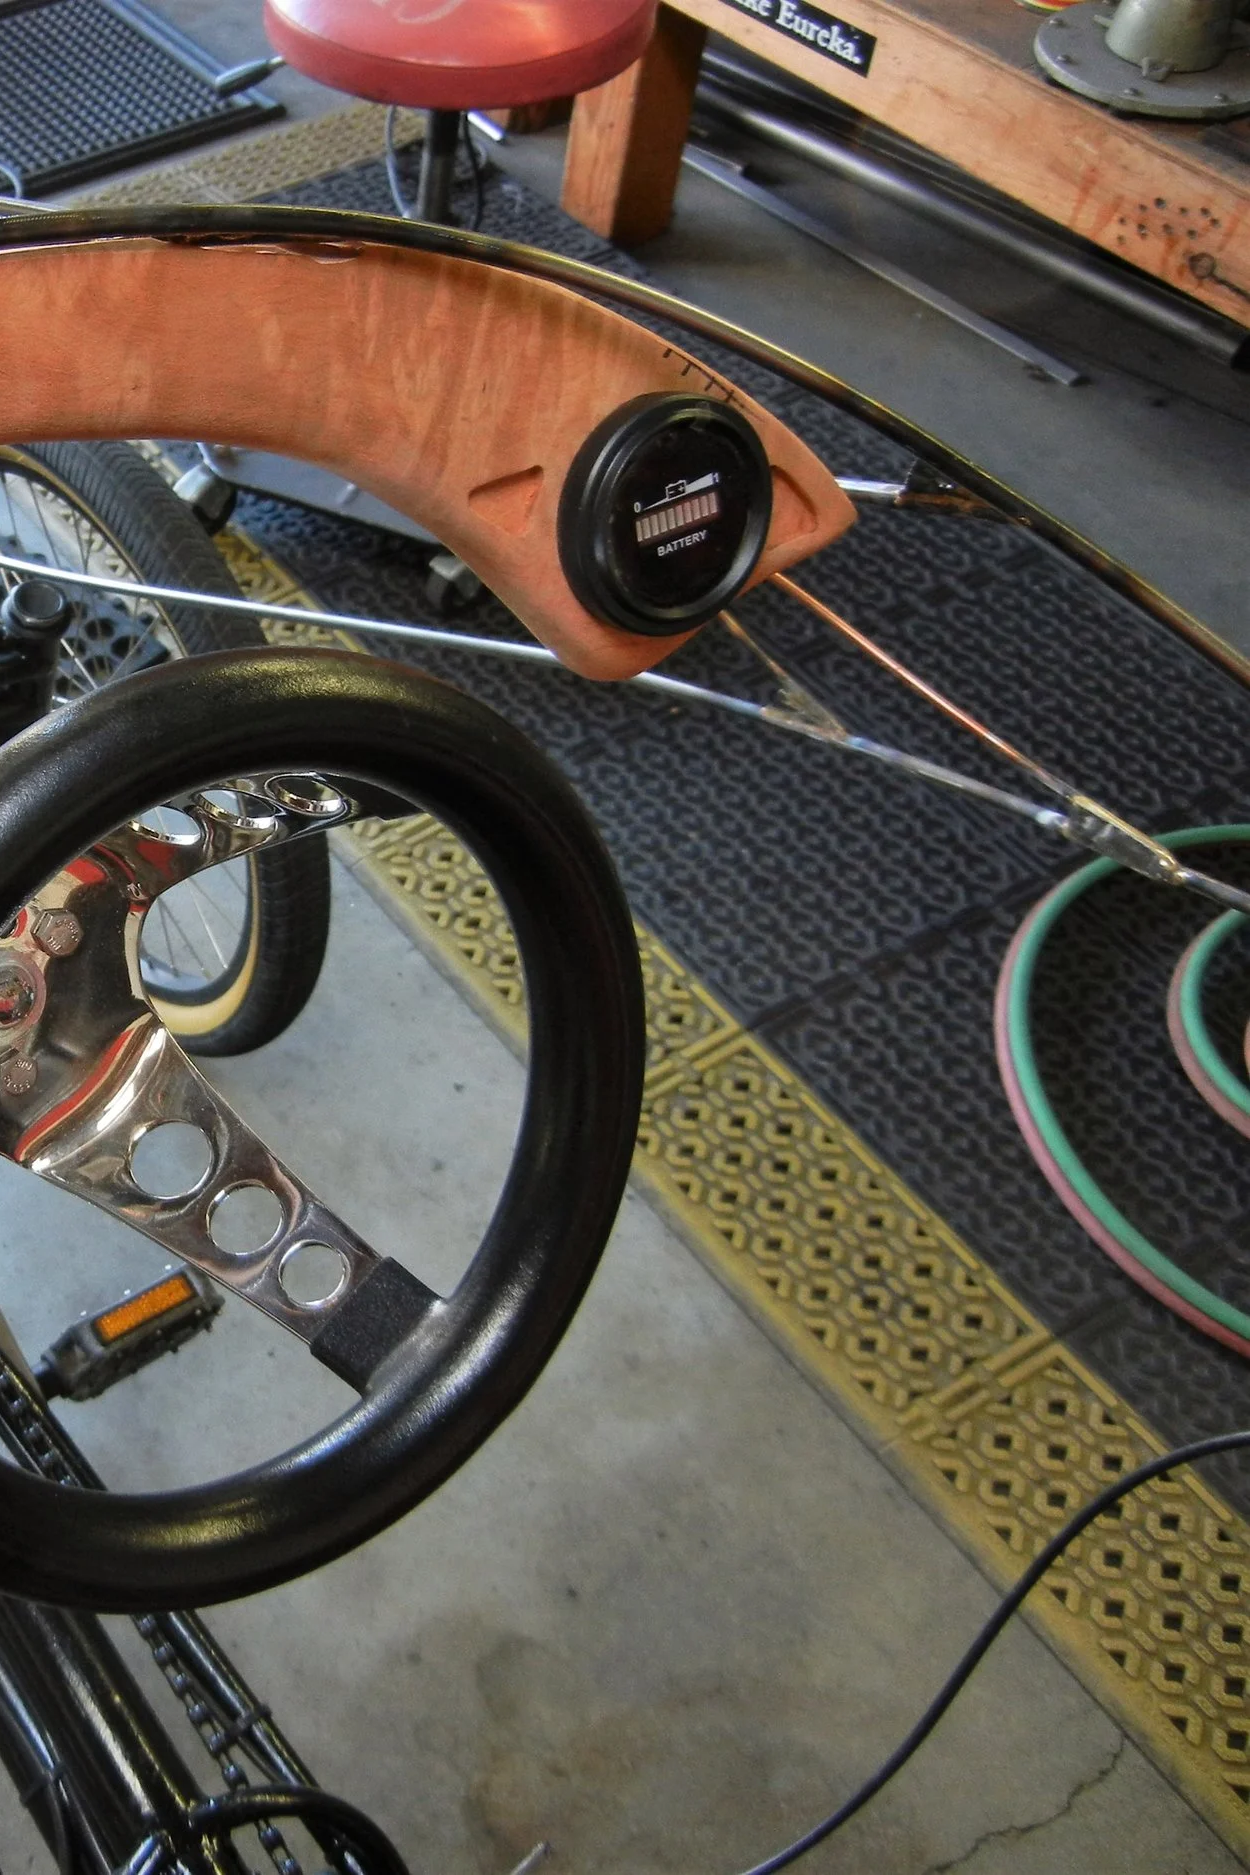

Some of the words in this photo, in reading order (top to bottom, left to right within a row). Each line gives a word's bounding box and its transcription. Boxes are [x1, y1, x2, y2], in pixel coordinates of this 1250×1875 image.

[775, 0, 862, 64] Eureka.
[634, 502, 642, 513] 0
[657, 529, 707, 556] BATTERY
